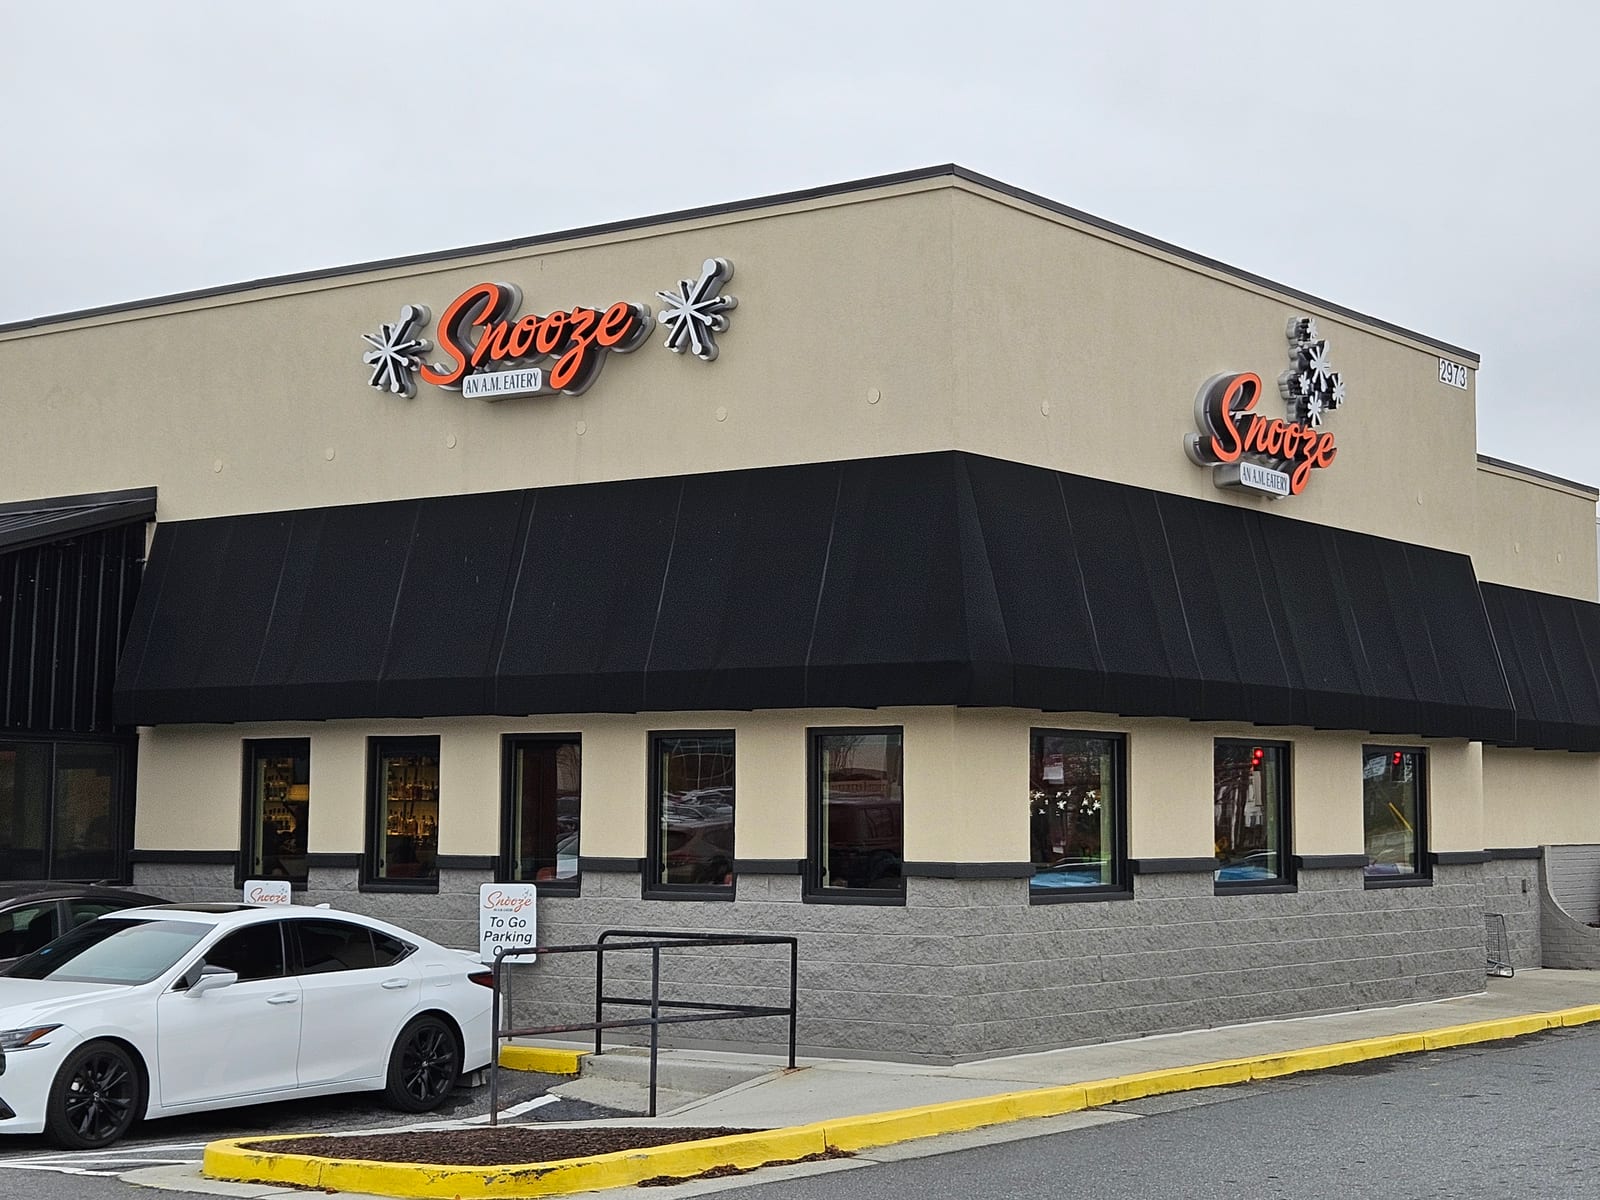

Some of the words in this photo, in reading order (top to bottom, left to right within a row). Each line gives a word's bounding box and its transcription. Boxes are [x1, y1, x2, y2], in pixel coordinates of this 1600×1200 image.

[420, 282, 633, 389] Snooze
[465, 379, 478, 393] AN
[481, 376, 501, 392] A.M.
[504, 372, 539, 390] EATERY
[1441, 360, 1465, 387] 2973
[1211, 371, 1337, 495] Snooze
[1242, 466, 1251, 482] AN
[1266, 472, 1288, 491] EATERY
[484, 891, 532, 912] Snooze
[490, 917, 504, 928] To
[508, 917, 527, 928] Go
[483, 931, 532, 945] Parking
